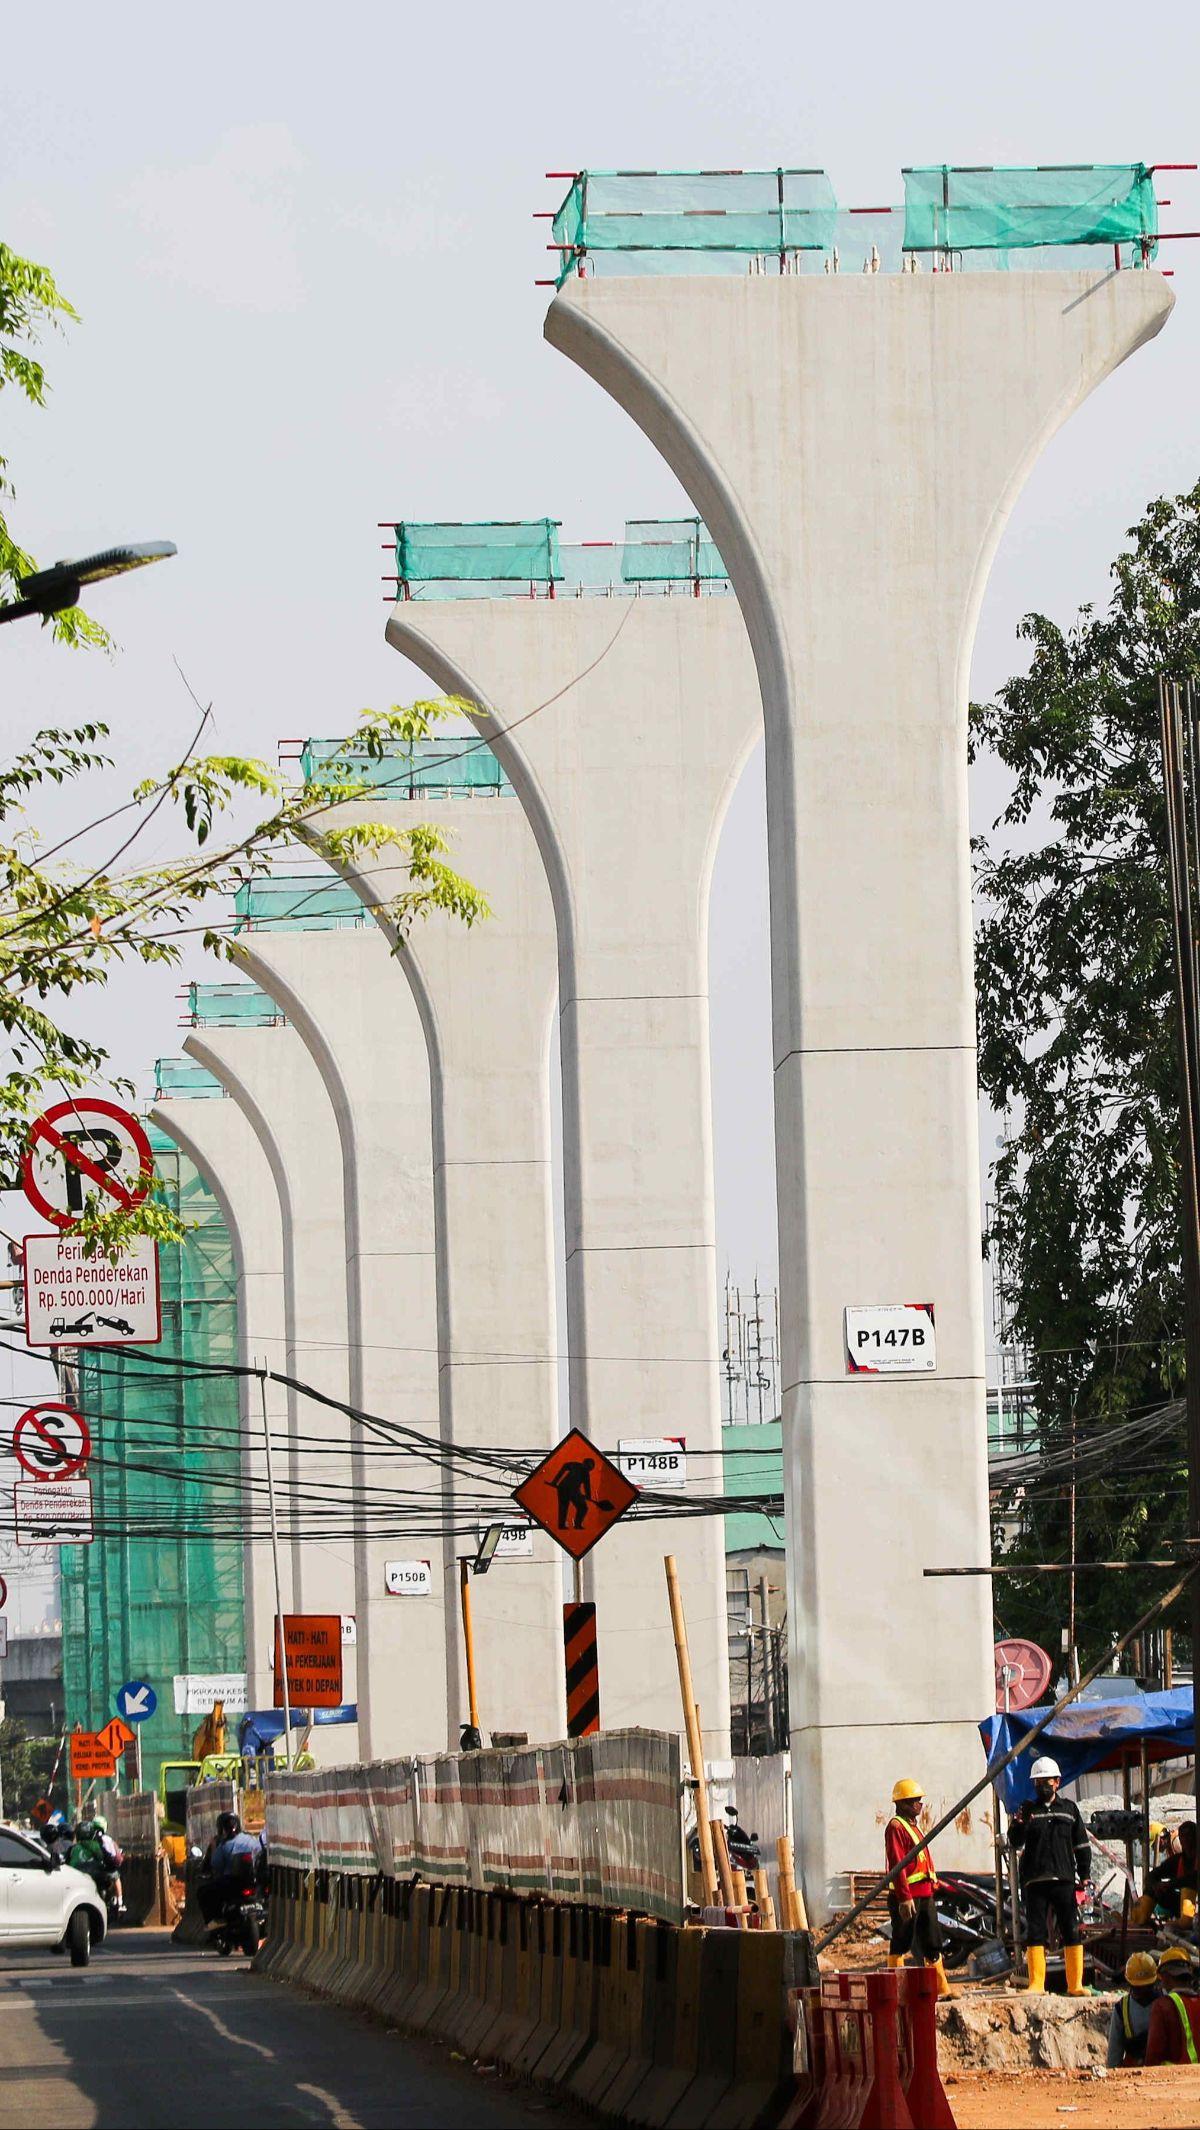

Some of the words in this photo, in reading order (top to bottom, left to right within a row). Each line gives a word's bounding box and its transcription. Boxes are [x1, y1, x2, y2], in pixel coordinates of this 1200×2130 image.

[57, 1242, 124, 1264] Perigaan
[34, 1266, 72, 1285] Denda
[76, 1264, 148, 1283] Penderekan
[39, 1291, 57, 1311] Rp.
[60, 1286, 145, 1307] 500.000/Hari
[857, 1328, 925, 1348] P147B
[627, 1455, 679, 1471] P148B
[391, 1572, 426, 1582] P150B
[287, 1631, 305, 1645] HATI
[311, 1631, 328, 1645] HATI
[295, 1654, 336, 1668] PEKERJAAN
[306, 1678, 313, 1692] DI
[315, 1678, 340, 1692] DEPAN
